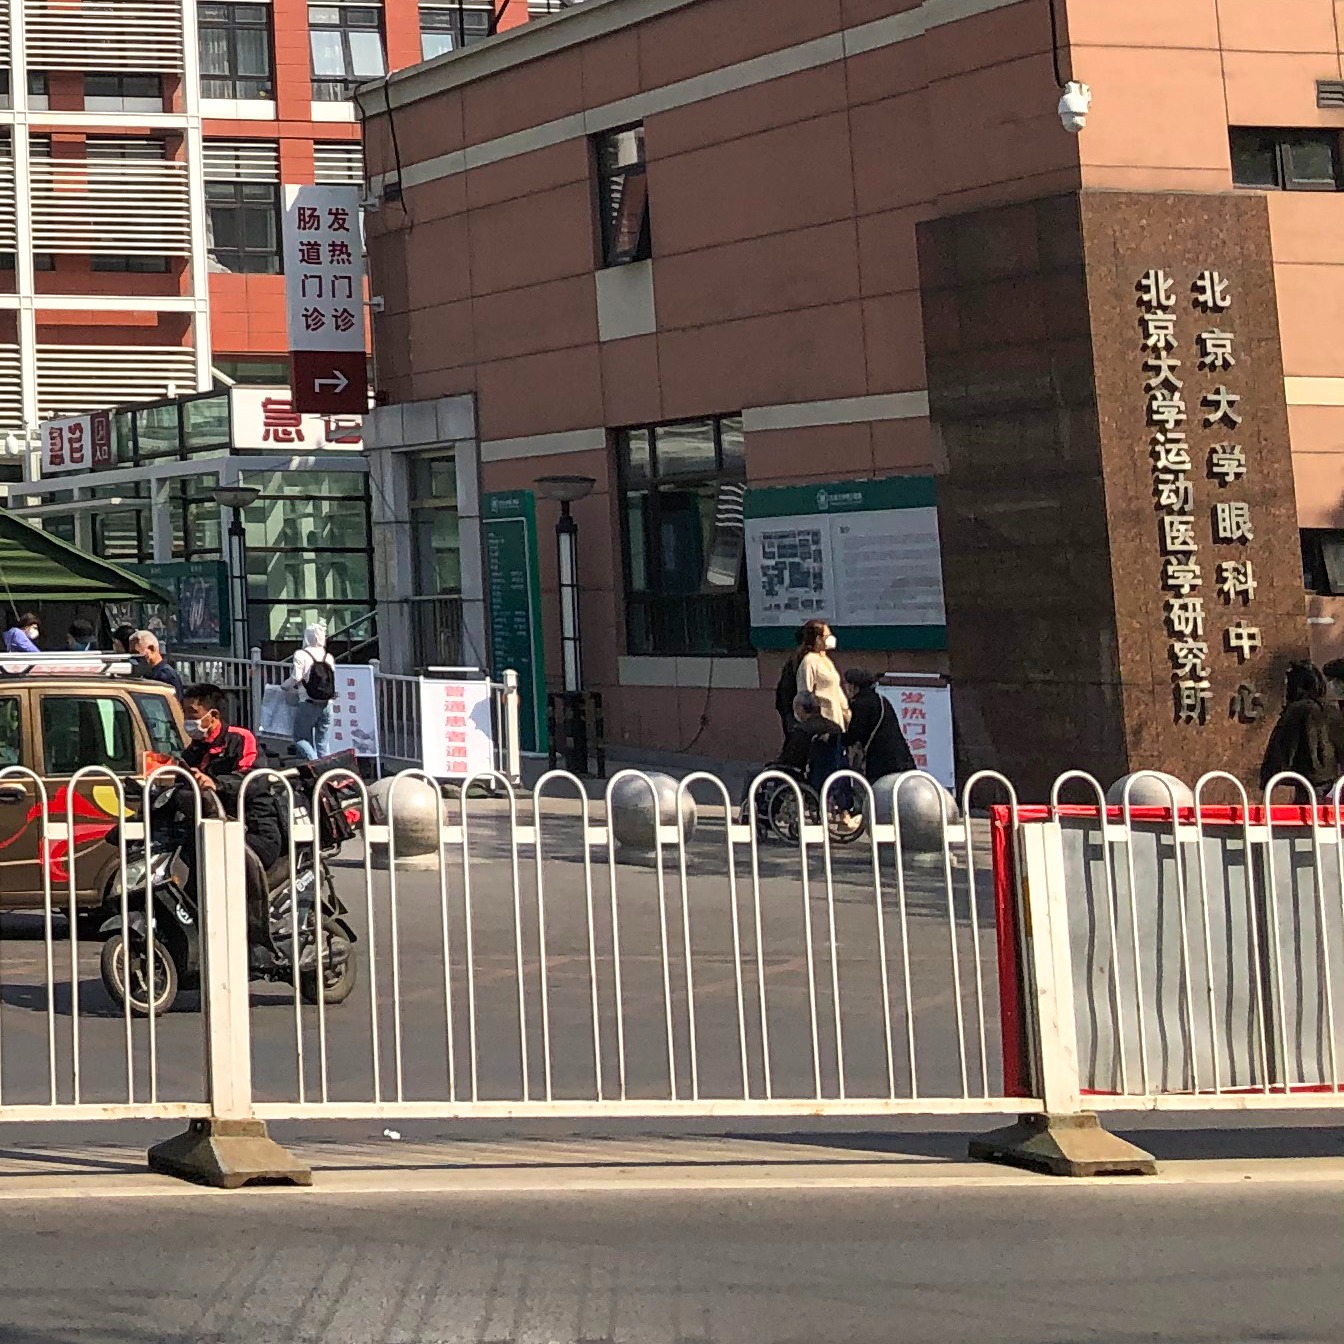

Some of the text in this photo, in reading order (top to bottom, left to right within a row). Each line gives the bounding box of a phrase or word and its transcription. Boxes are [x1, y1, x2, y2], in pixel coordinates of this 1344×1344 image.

[297, 206, 325, 332] 肠道门诊
[327, 207, 355, 332] 发热门诊
[48, 422, 85, 466] 急诊
[1141, 269, 1212, 724] 北京大学运动医学研究所
[1196, 271, 1264, 722] 北京大学眼科中心
